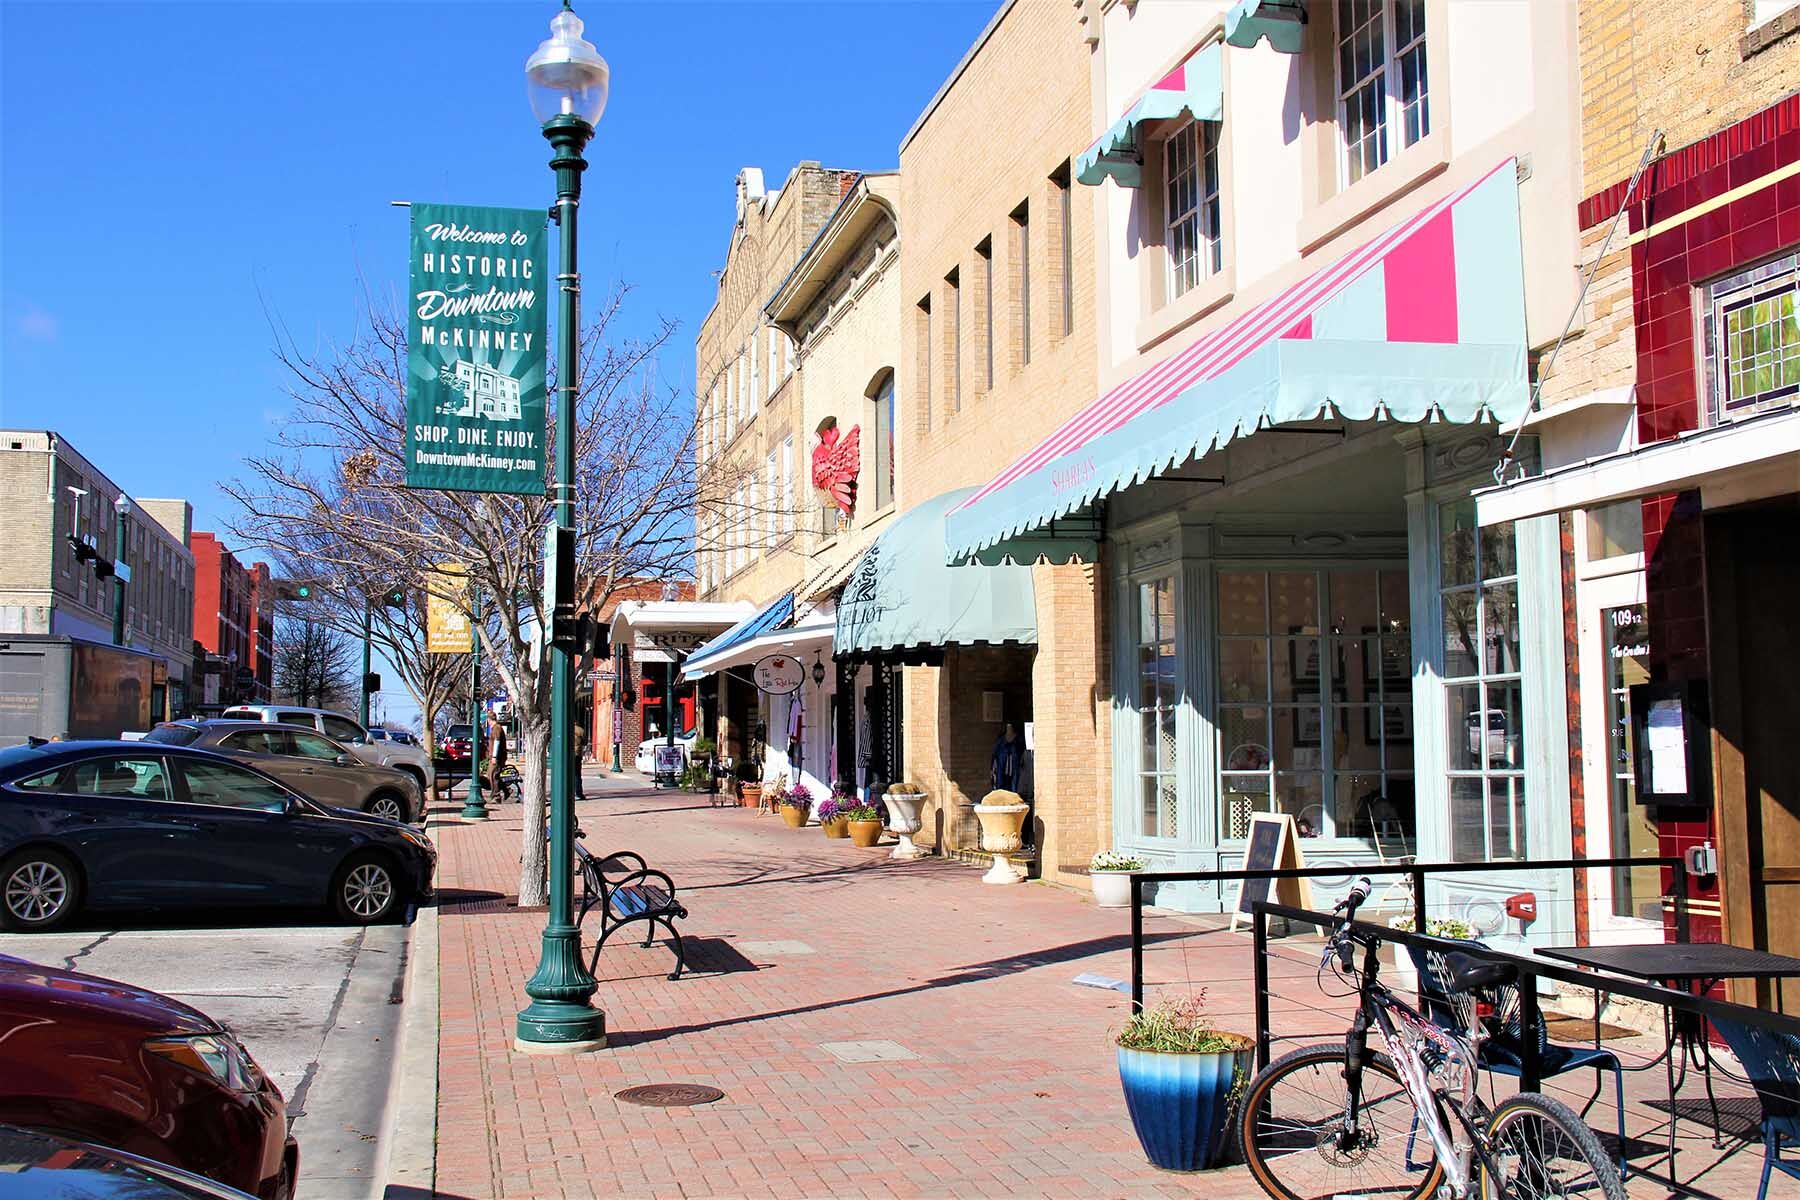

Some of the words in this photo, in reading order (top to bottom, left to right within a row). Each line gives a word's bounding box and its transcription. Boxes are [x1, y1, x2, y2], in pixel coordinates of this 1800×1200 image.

[424, 223, 507, 245] Welcome
[510, 229, 528, 246] to
[423, 253, 532, 279] HISTORIC
[416, 286, 536, 320] Downtown
[421, 326, 532, 352] McKINNEY
[415, 425, 453, 443] SHOP.
[458, 427, 492, 446] DINE.
[497, 430, 538, 449] ENJOY.
[416, 449, 536, 473] DowntownMcKinney.com
[1611, 609, 1632, 626] 109
